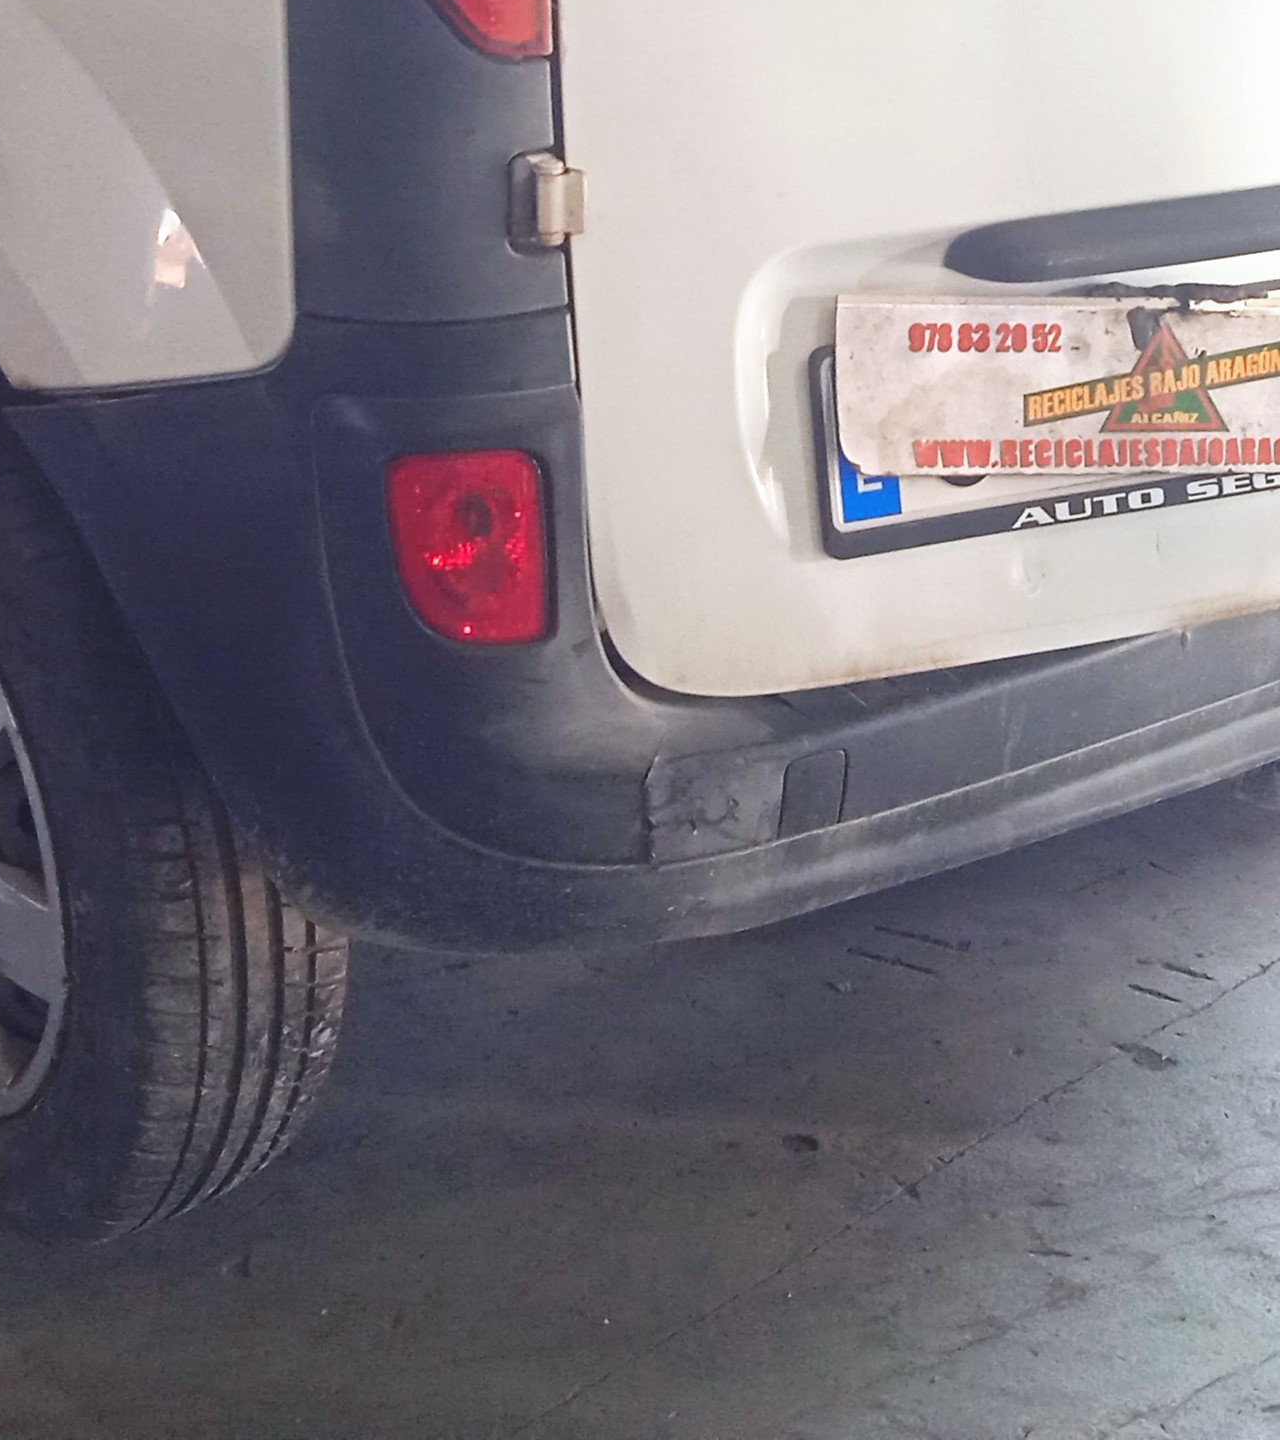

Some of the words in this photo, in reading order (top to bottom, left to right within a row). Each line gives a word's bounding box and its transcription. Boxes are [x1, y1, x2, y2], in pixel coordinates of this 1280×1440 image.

[908, 322, 952, 353] 978
[958, 322, 991, 353] 83
[996, 322, 1028, 353] 20
[1032, 323, 1062, 353] 52
[1027, 374, 1145, 421] RECICLAJES
[1150, 363, 1202, 395] BAJO
[1012, 487, 1165, 529] AUTO
